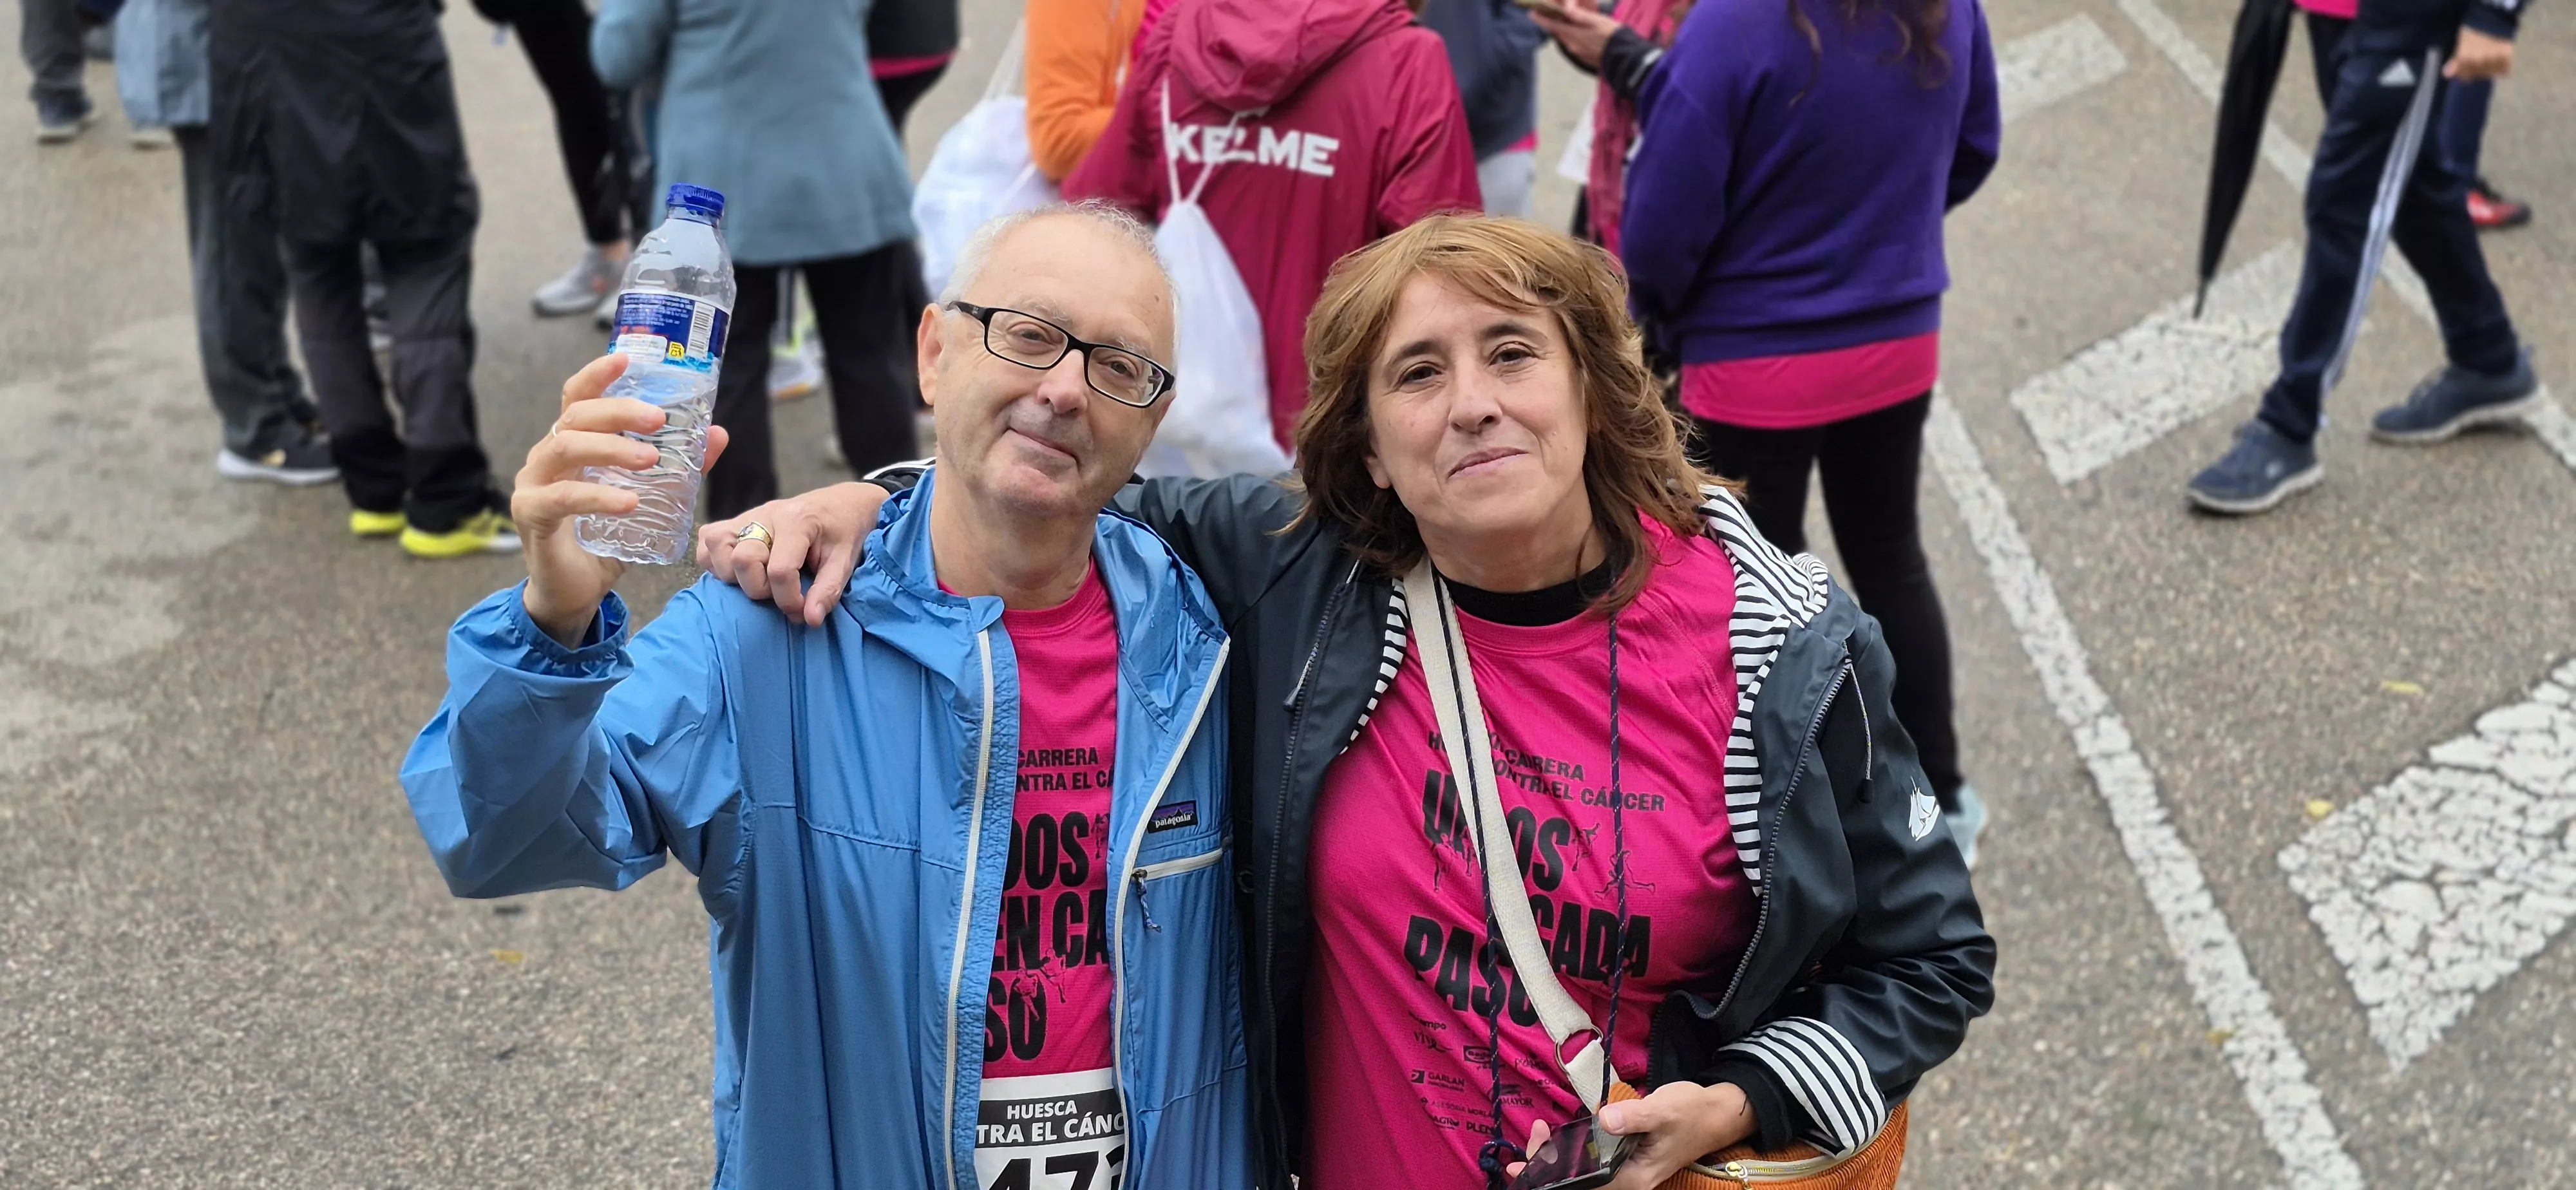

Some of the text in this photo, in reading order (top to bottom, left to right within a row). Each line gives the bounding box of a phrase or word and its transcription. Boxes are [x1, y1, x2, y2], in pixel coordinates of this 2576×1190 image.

[1168, 122, 1340, 177] KELME
[1018, 748, 1099, 769] CARRERA
[1072, 772, 1092, 789] EL
[1492, 759, 1550, 795] ONTR
[1551, 780, 1574, 802] EL
[1428, 1072, 1465, 1087] GARLAN
[1007, 1100, 1077, 1120] HUESCA
[1032, 1121, 1057, 1142] EL
